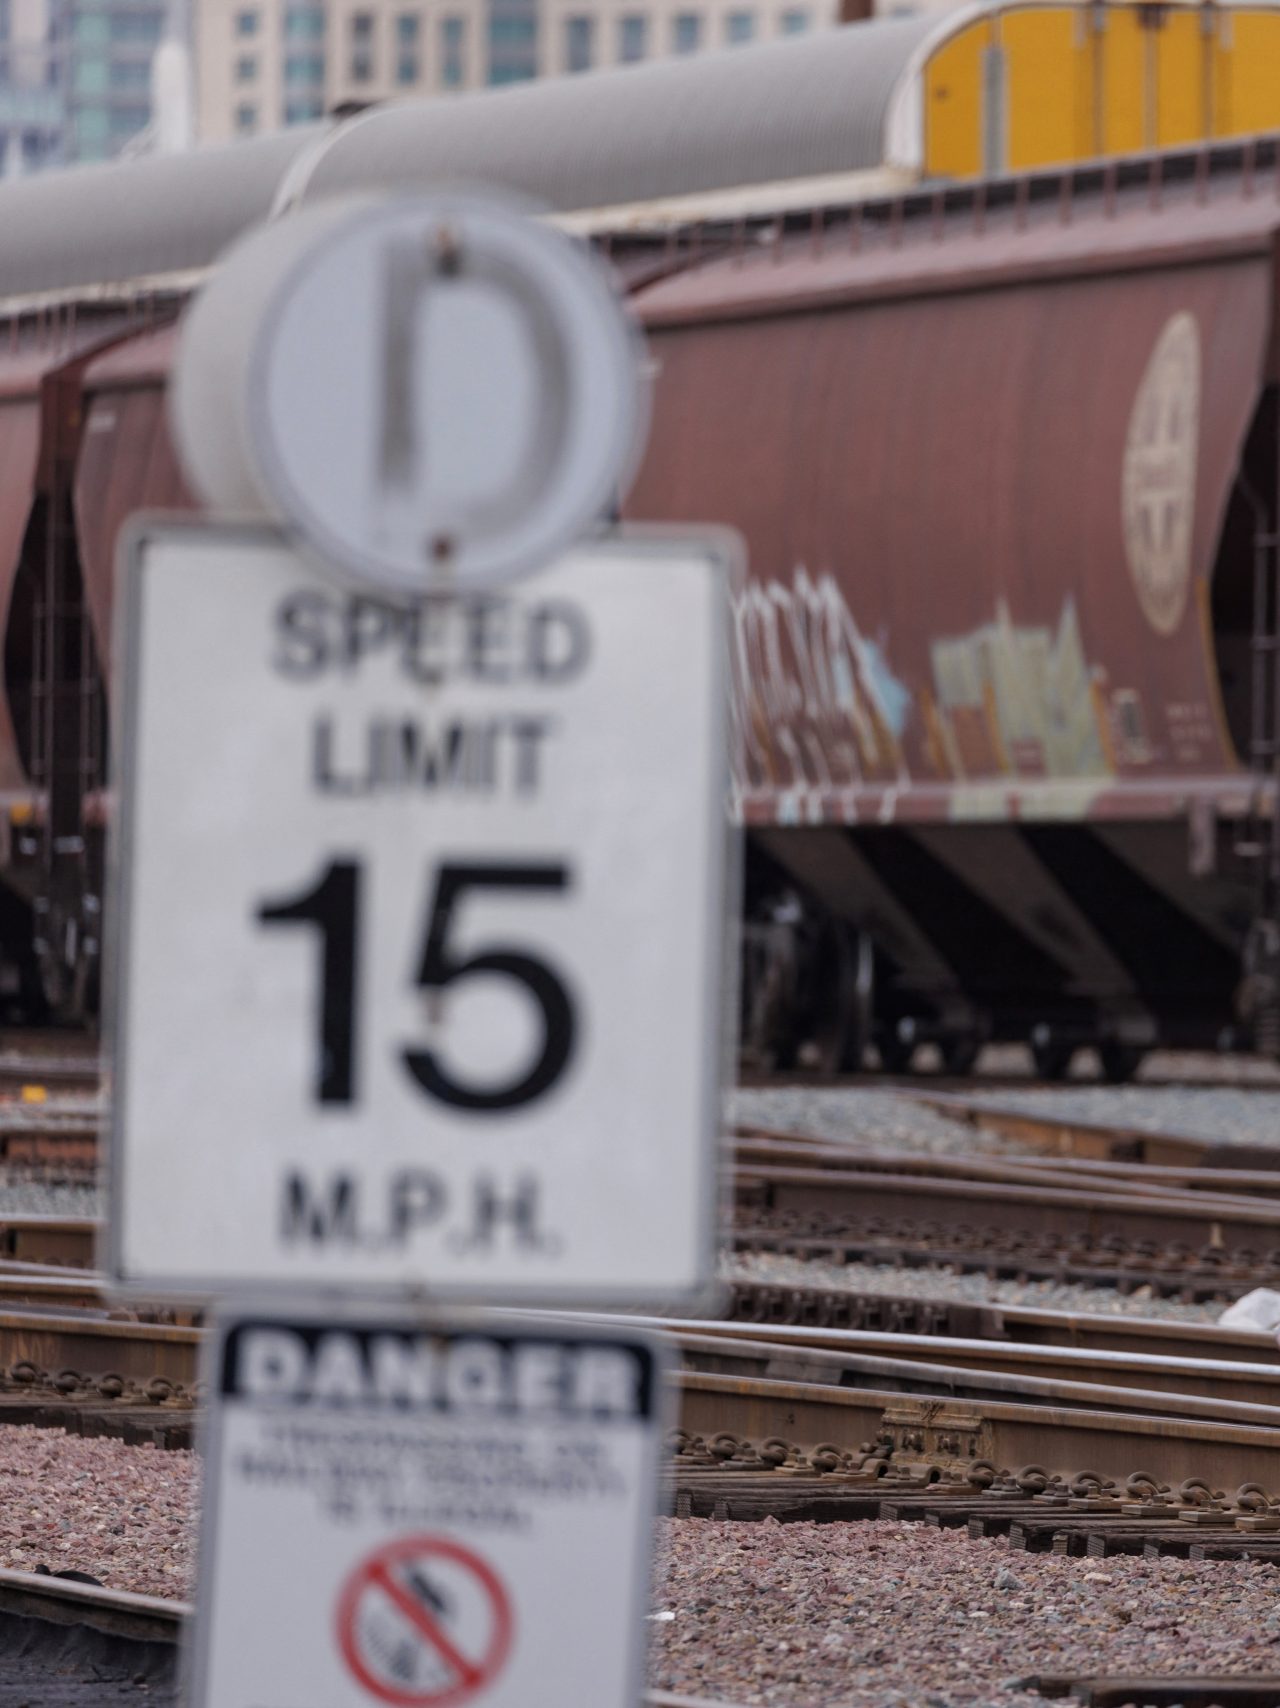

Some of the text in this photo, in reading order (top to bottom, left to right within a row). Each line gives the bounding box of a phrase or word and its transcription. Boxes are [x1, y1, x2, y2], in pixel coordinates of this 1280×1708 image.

[370, 240, 580, 535] D
[270, 592, 594, 689] SPEED
[311, 713, 560, 803] LIMIT
[253, 853, 584, 1115] 15
[277, 1166, 566, 1256] M.P.H.
[237, 1328, 642, 1416] DANGER
